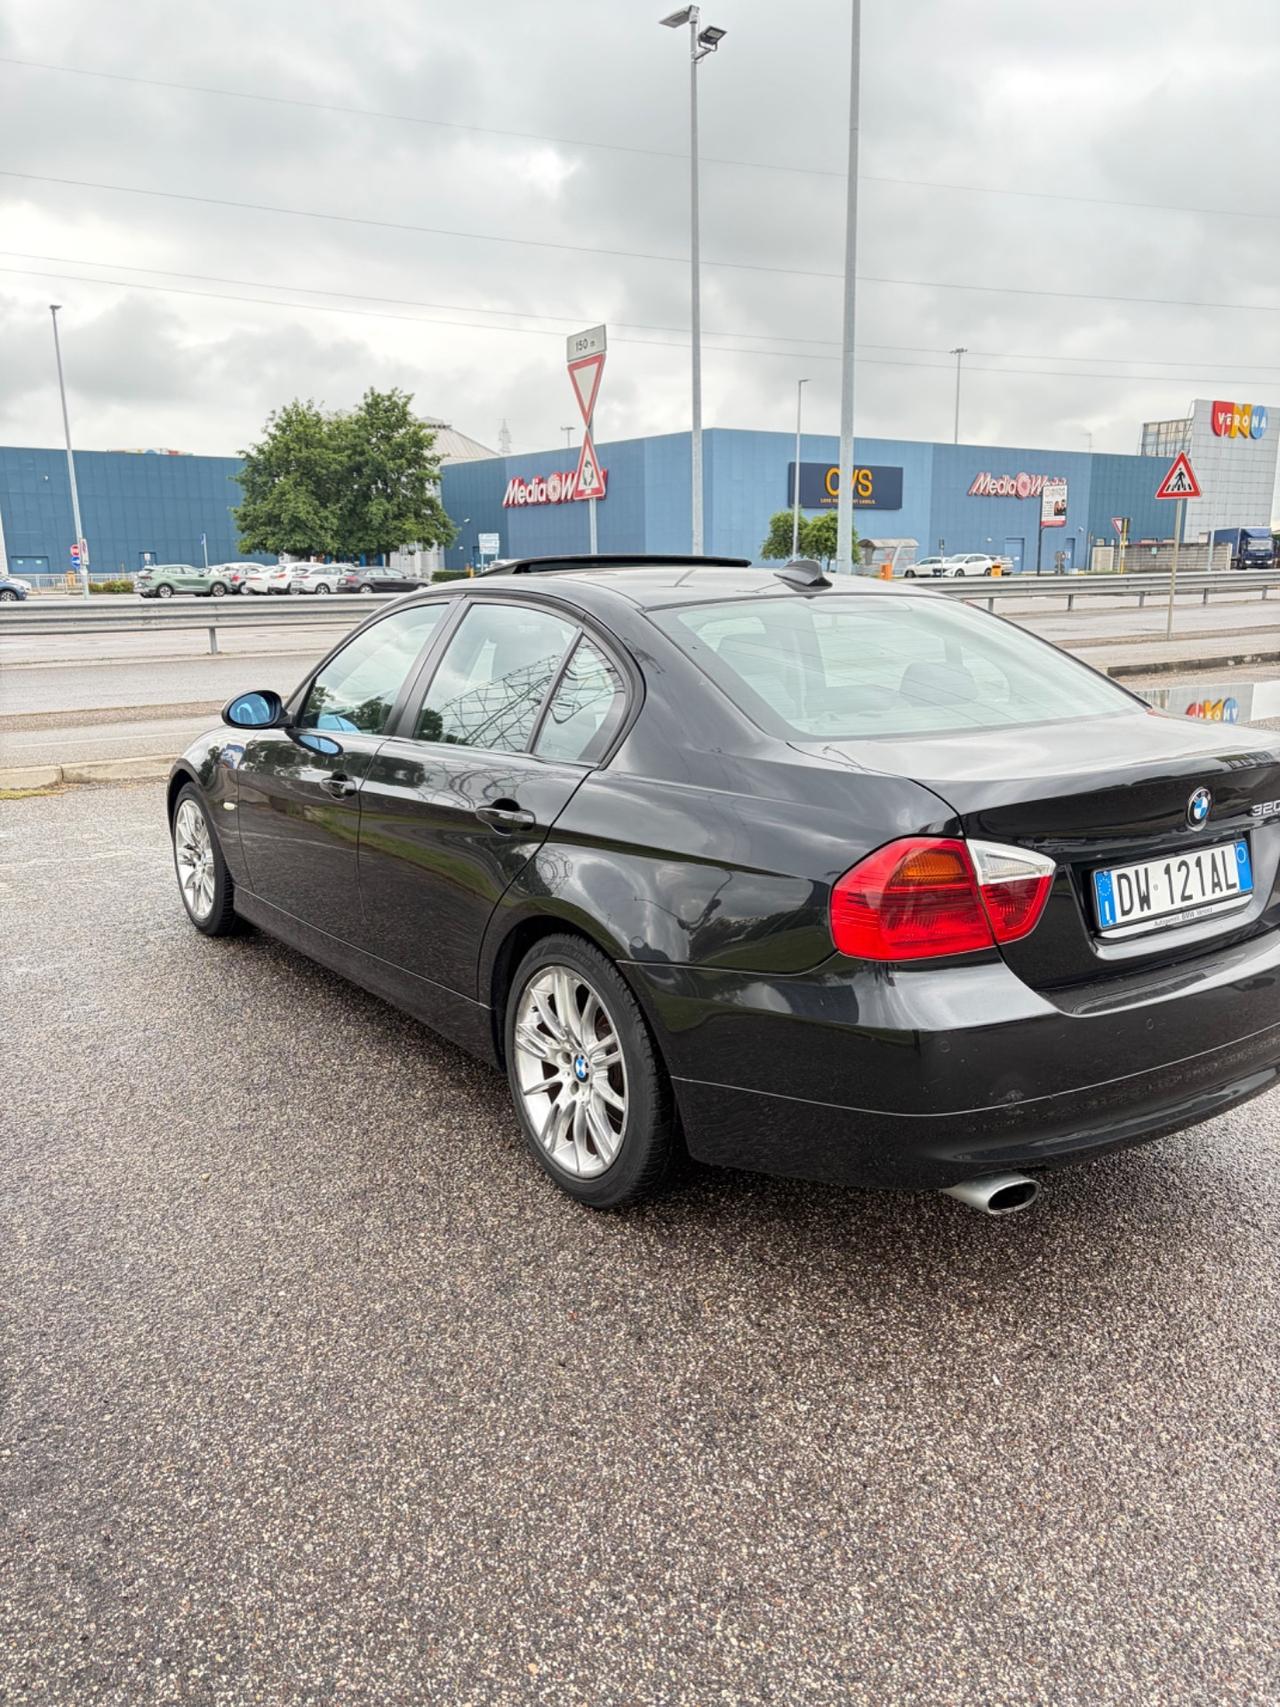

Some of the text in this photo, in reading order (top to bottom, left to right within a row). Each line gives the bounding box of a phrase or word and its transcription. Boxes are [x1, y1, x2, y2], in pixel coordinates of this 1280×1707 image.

[575, 338, 588, 351] 150
[1218, 412, 1267, 428] VERONA
[1116, 850, 1237, 917] DW 121AL
